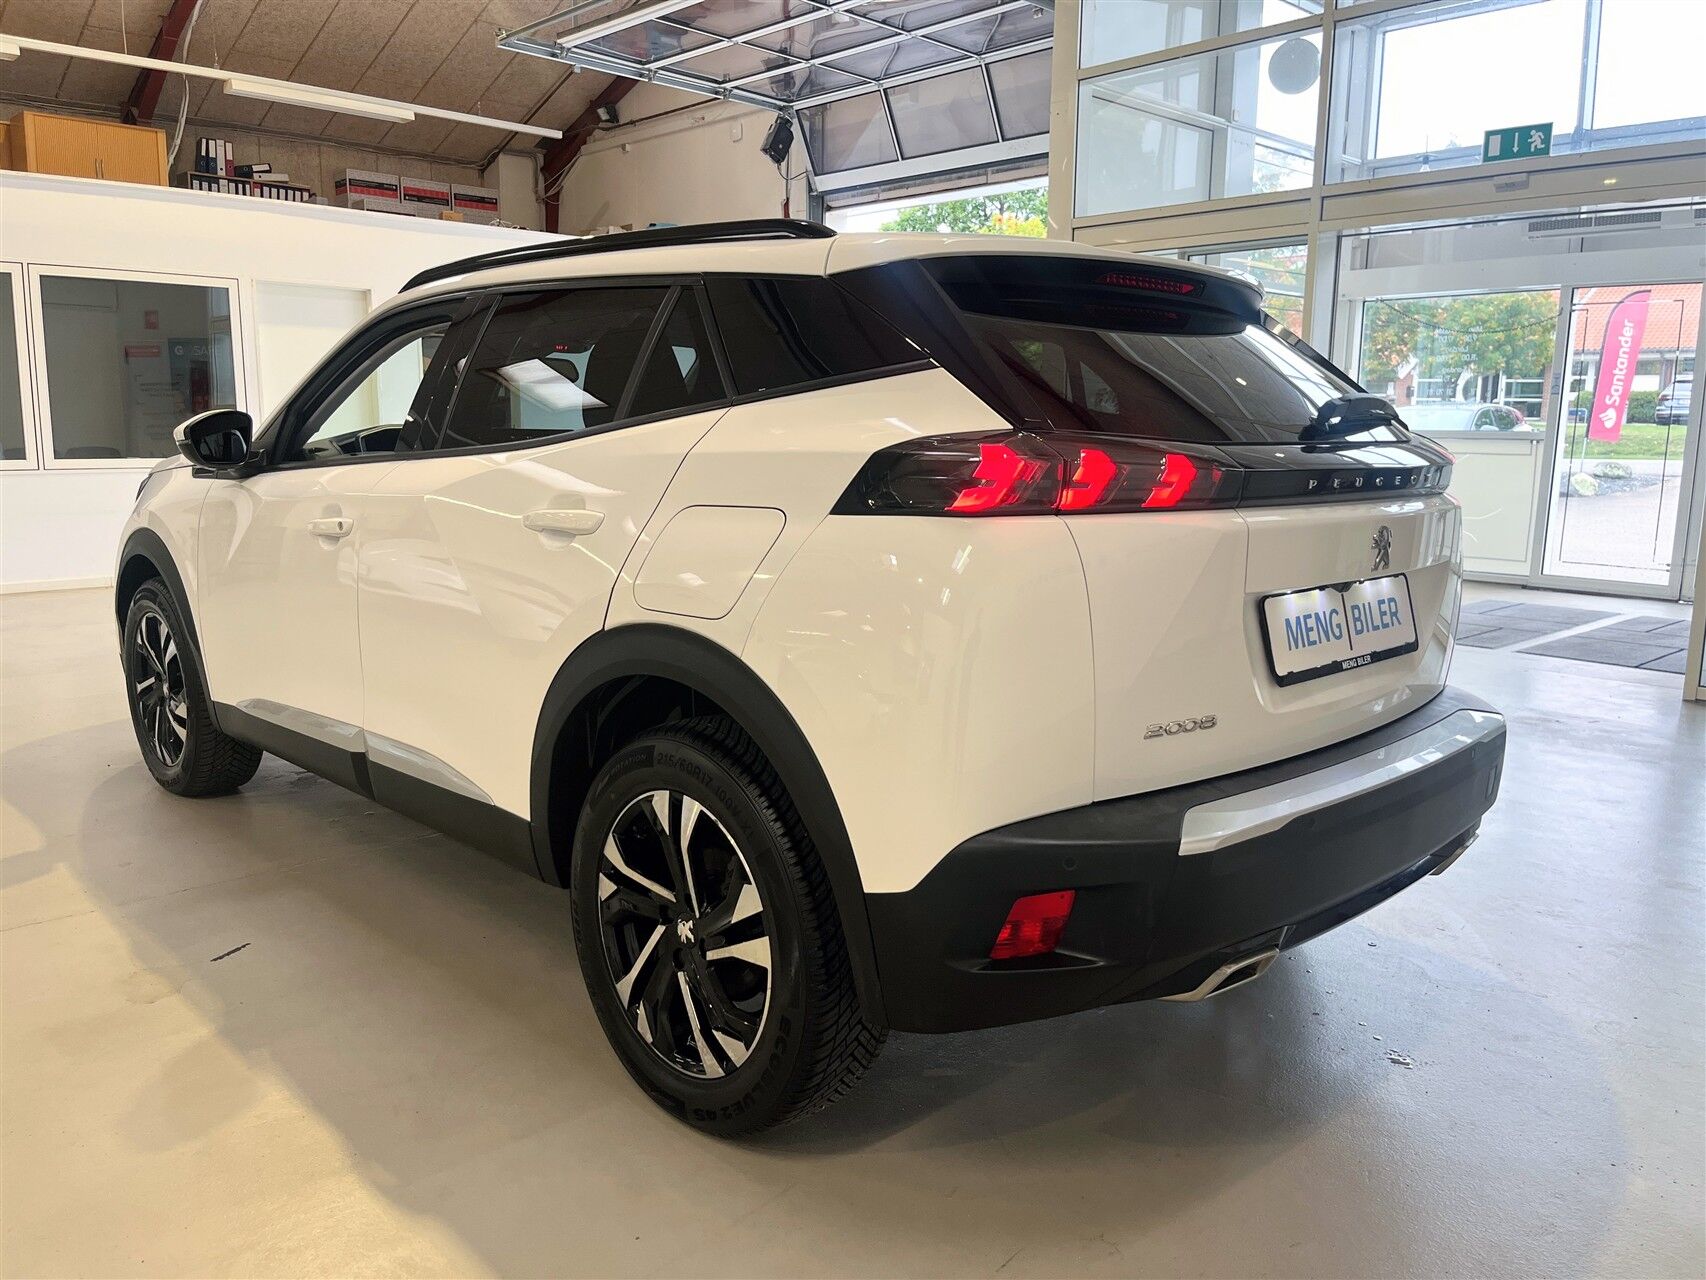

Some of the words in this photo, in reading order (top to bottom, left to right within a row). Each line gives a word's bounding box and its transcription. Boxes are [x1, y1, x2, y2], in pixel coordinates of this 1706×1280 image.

[1604, 318, 1635, 407] Santander
[1284, 608, 1344, 651] MENG
[1350, 597, 1402, 636] BILER
[1341, 659, 1358, 670] MENG
[1357, 654, 1372, 667] BILER
[1143, 714, 1218, 740] 2008
[656, 752, 713, 787] 215/60R17
